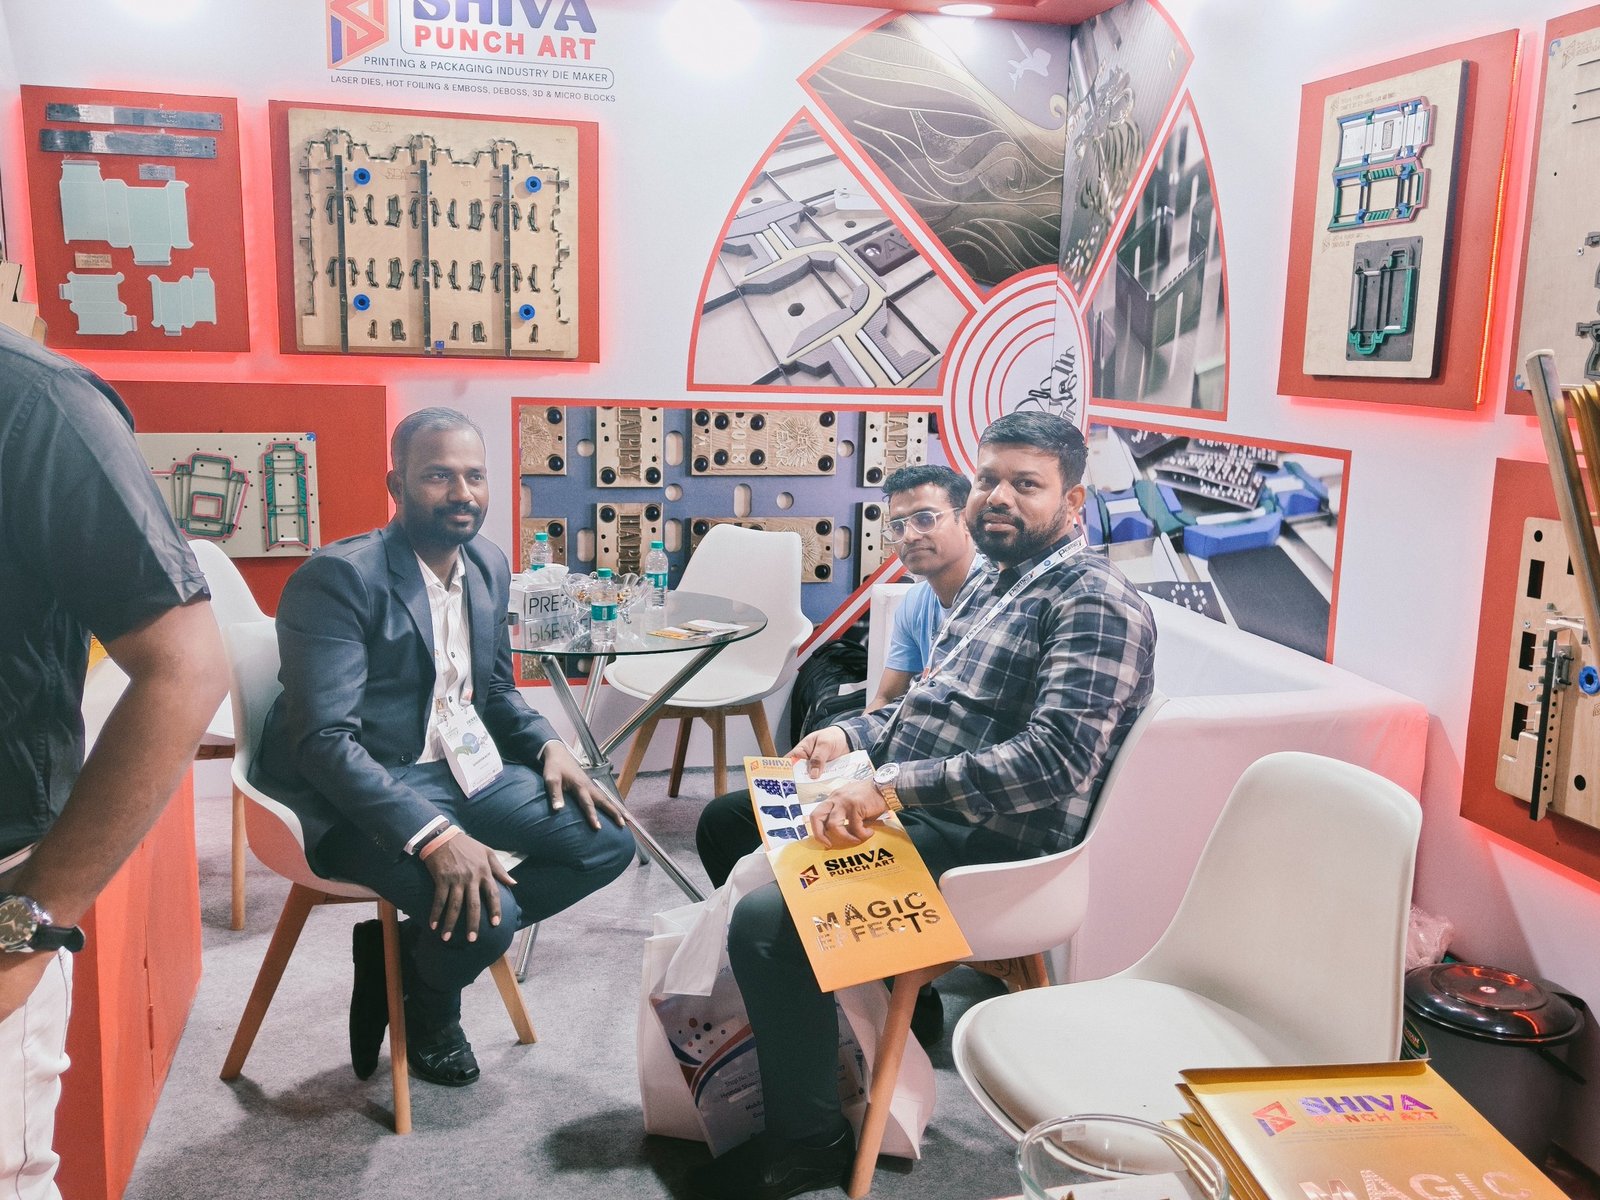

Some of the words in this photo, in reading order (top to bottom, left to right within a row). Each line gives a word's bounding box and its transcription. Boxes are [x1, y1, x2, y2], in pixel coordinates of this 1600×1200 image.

[414, 25, 524, 55] PUNCH
[537, 35, 597, 60] ART
[364, 56, 416, 68] PRINTING
[419, 60, 427, 69] &
[430, 61, 493, 74] PACKAGING
[496, 66, 549, 78] INDUSTRY
[552, 70, 569, 80] DIE
[572, 71, 608, 83] MAKER
[330, 75, 359, 85] LASER
[361, 77, 384, 87] DIES,
[386, 79, 404, 88] HOT
[406, 80, 441, 91] FOILING
[443, 83, 450, 91] &
[452, 83, 490, 94] EMBOSS,
[493, 87, 530, 97] DEBOSS,
[532, 89, 544, 97] 3D
[546, 90, 552, 98] &
[554, 91, 581, 100] MICRO
[583, 93, 616, 103] BLOCKS
[731, 418, 747, 464] 2018
[775, 417, 791, 467] YEAR
[618, 514, 641, 576] HAPP
[762, 759, 791, 767] SHIVA
[824, 848, 894, 872] SHIVA
[829, 865, 871, 877] PUNCH
[874, 857, 896, 868] ART
[812, 891, 927, 933] MAGIC
[1300, 1094, 1434, 1116] SHIVA
[1313, 1113, 1393, 1127] PUNCH
[1400, 1111, 1440, 1121] ART
[1299, 1169, 1533, 1200] MAGIC
